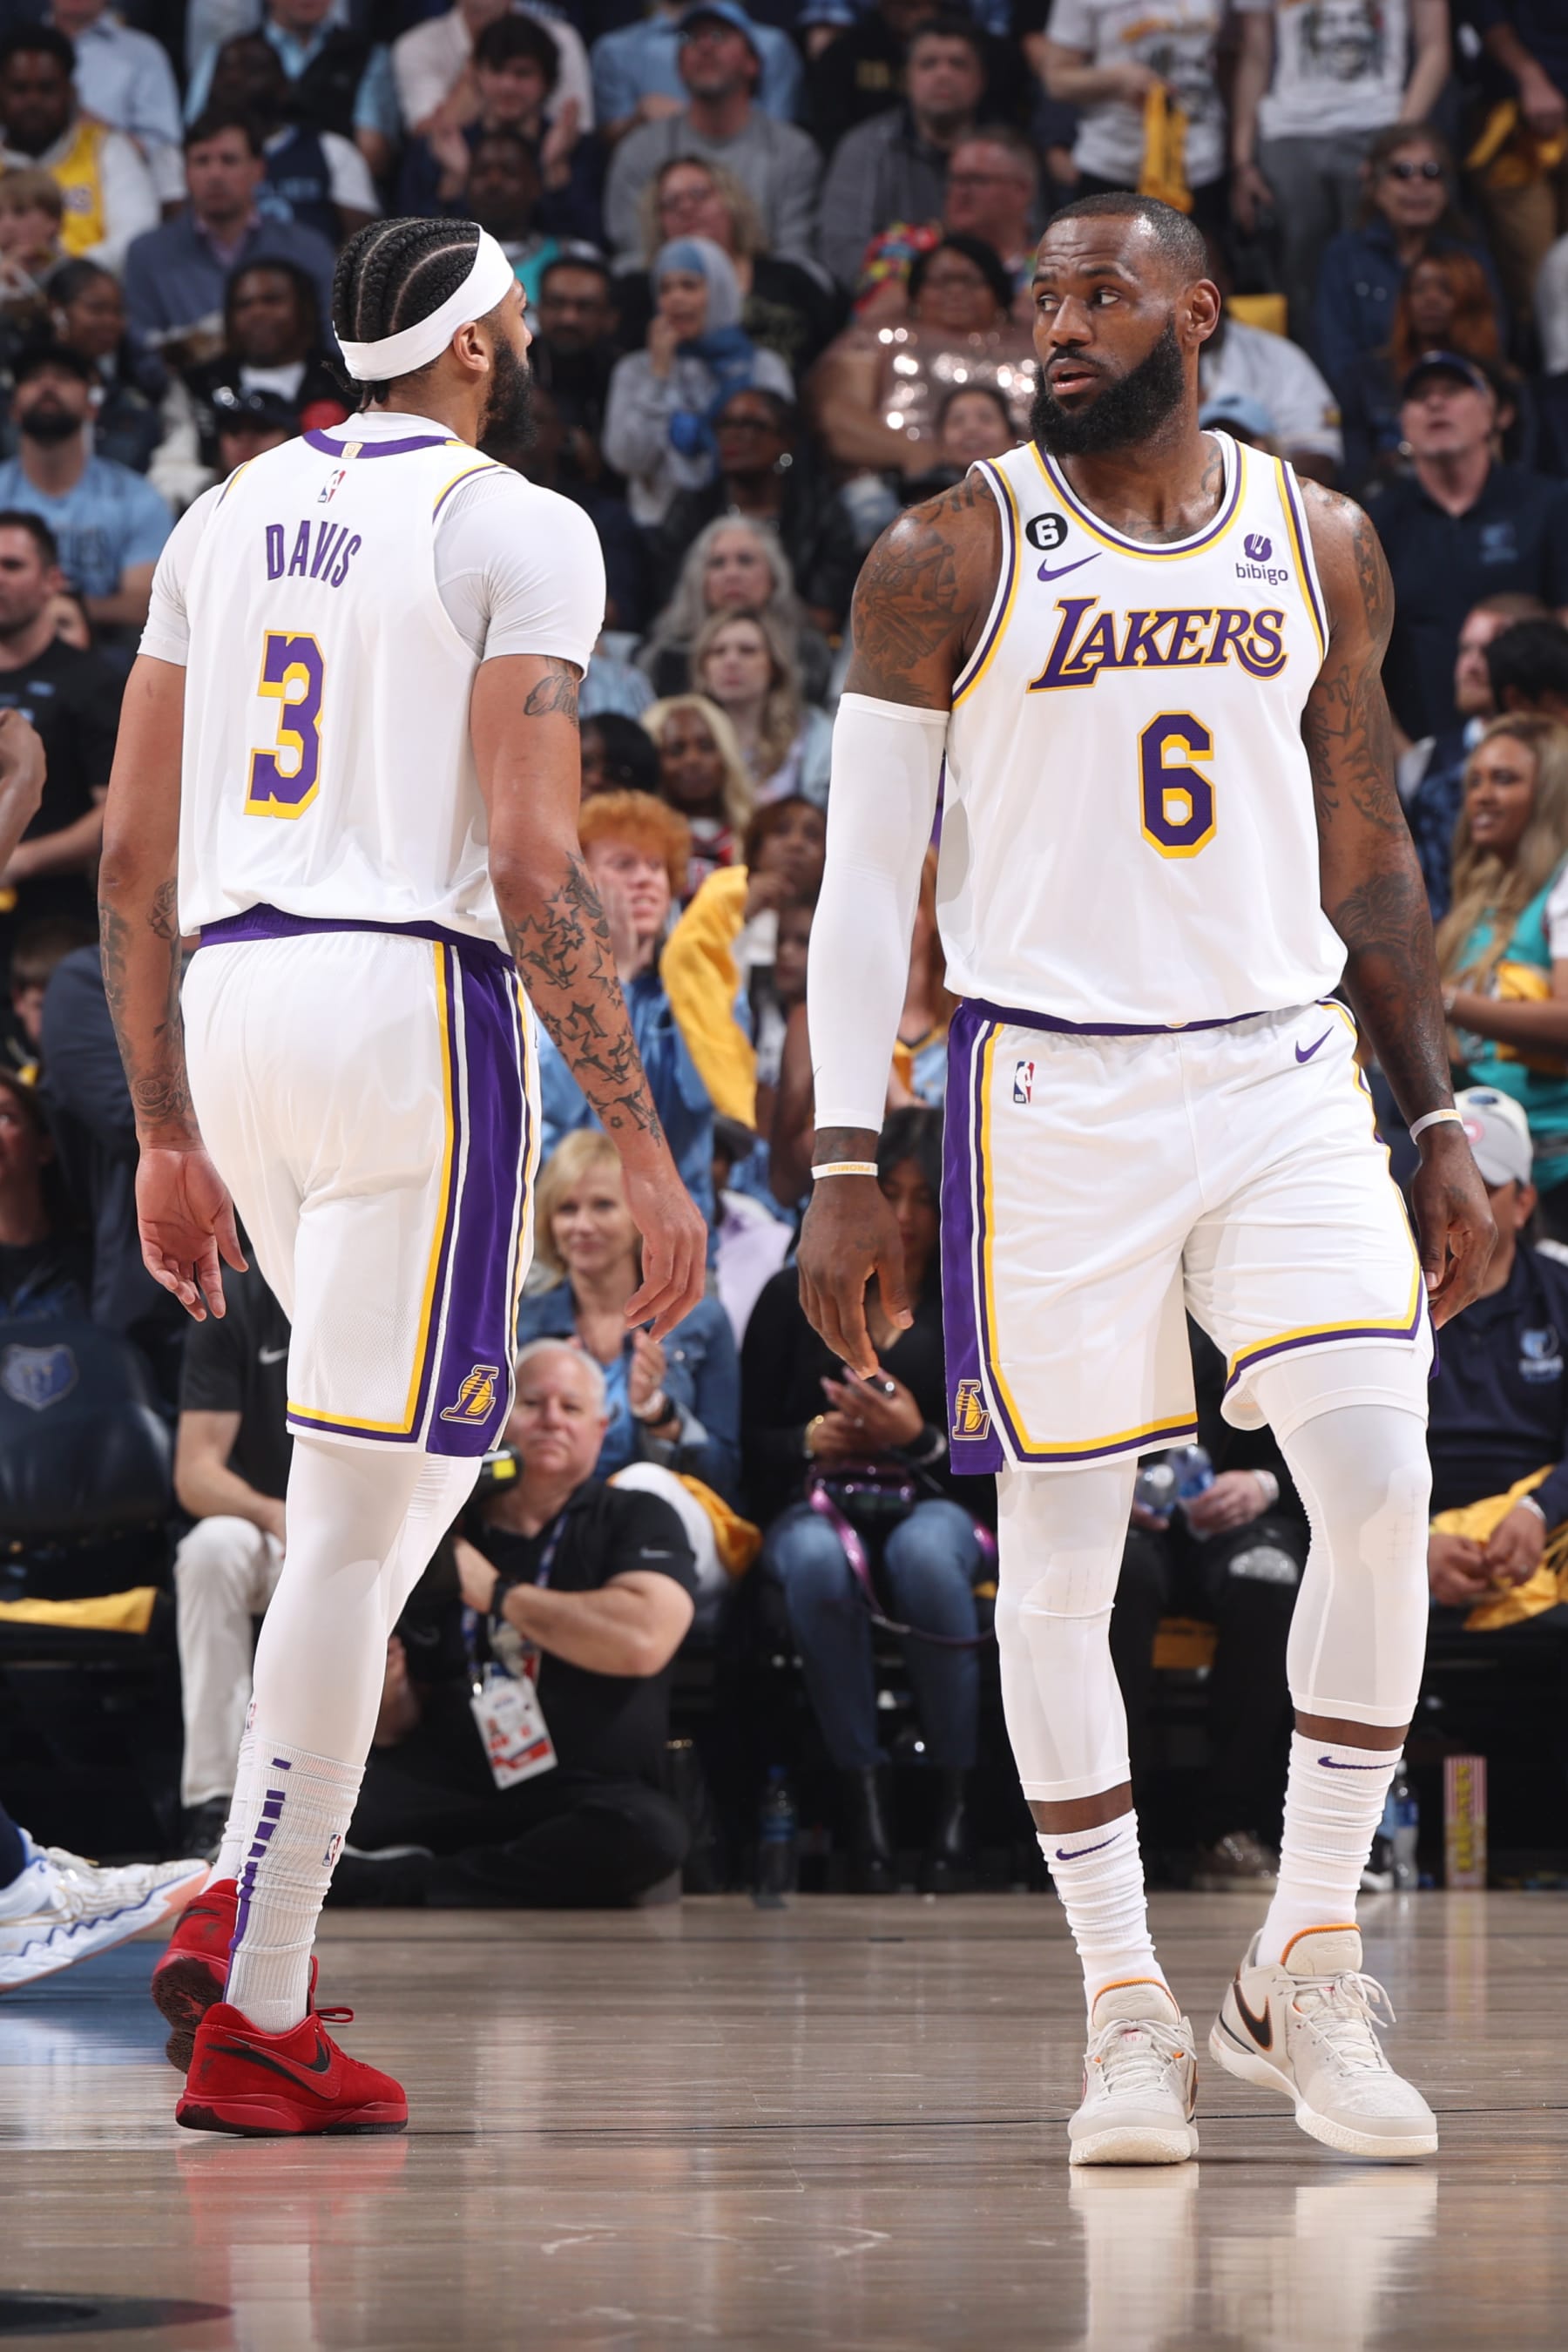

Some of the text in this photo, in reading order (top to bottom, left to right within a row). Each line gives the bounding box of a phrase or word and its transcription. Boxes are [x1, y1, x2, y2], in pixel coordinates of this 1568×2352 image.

[266, 520, 362, 588] DAVIS
[1035, 517, 1059, 546] 6
[1235, 563, 1288, 585] bibigo
[1025, 595, 1289, 693] LAKERS
[243, 630, 327, 821] 3
[1137, 710, 1217, 860] 6
